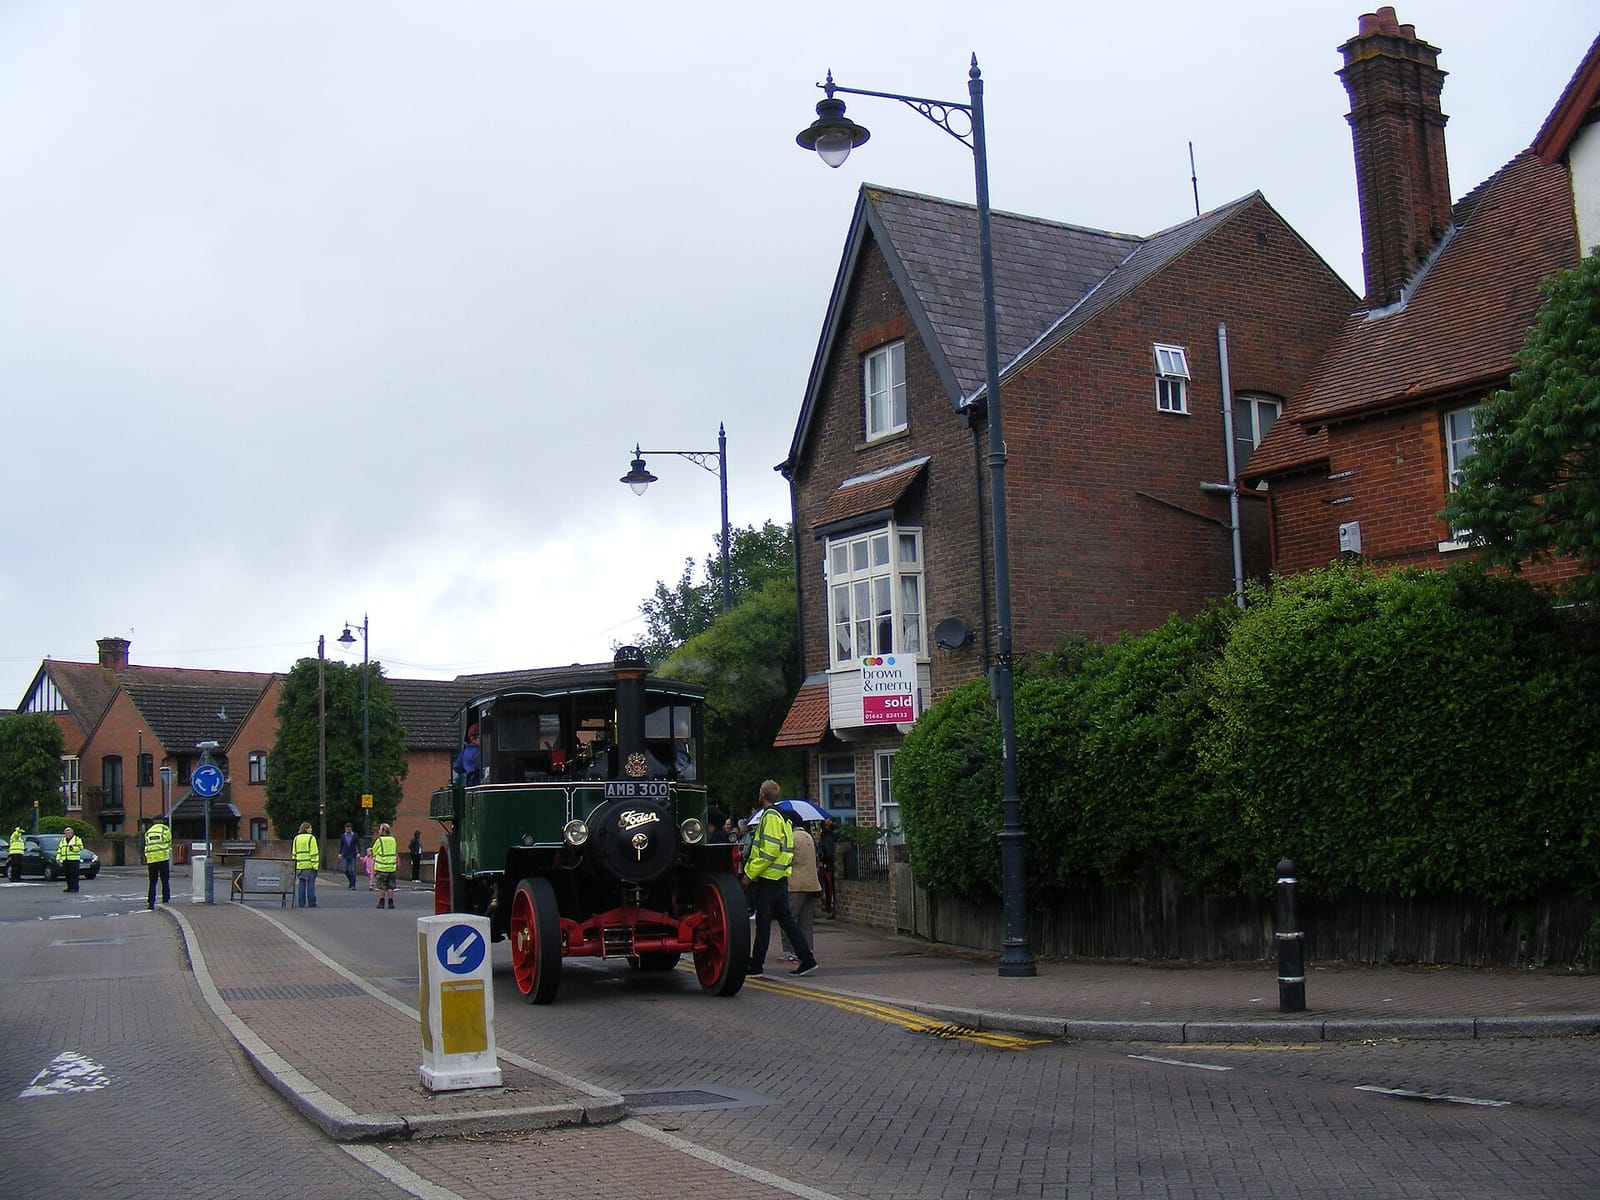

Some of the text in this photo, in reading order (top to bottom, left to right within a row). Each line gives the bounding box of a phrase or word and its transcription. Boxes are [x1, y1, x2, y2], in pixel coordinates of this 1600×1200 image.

[863, 667, 902, 679] brown
[863, 680, 912, 693] & merry
[884, 696, 912, 708] sold
[607, 784, 668, 796] AMB 300
[618, 810, 660, 829] Foden
